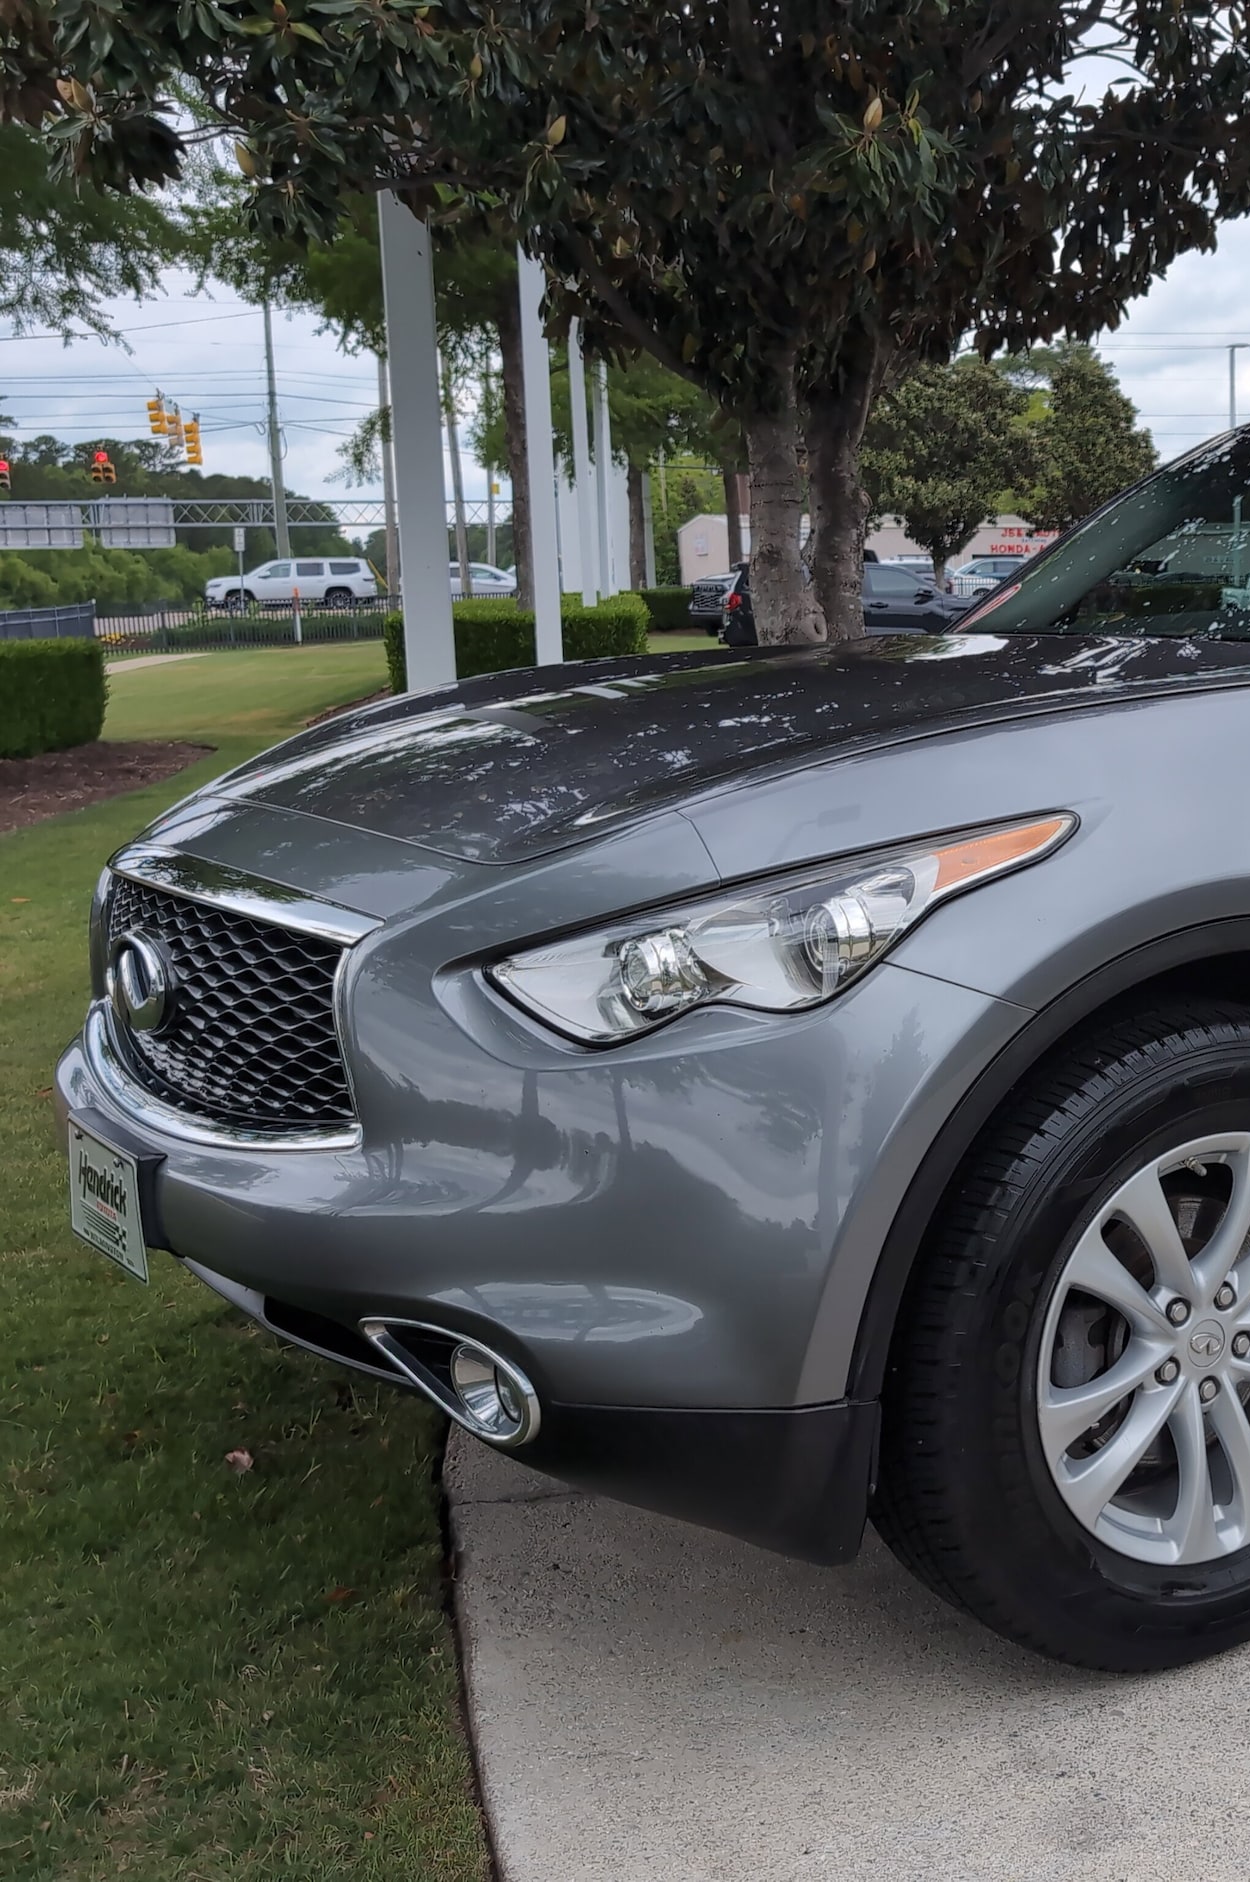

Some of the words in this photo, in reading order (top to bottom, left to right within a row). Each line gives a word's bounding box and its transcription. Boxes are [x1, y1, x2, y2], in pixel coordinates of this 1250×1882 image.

[990, 544, 1031, 554] HONDA
[78, 1150, 127, 1218] Hendrick
[96, 1200, 118, 1221] TOYOTA
